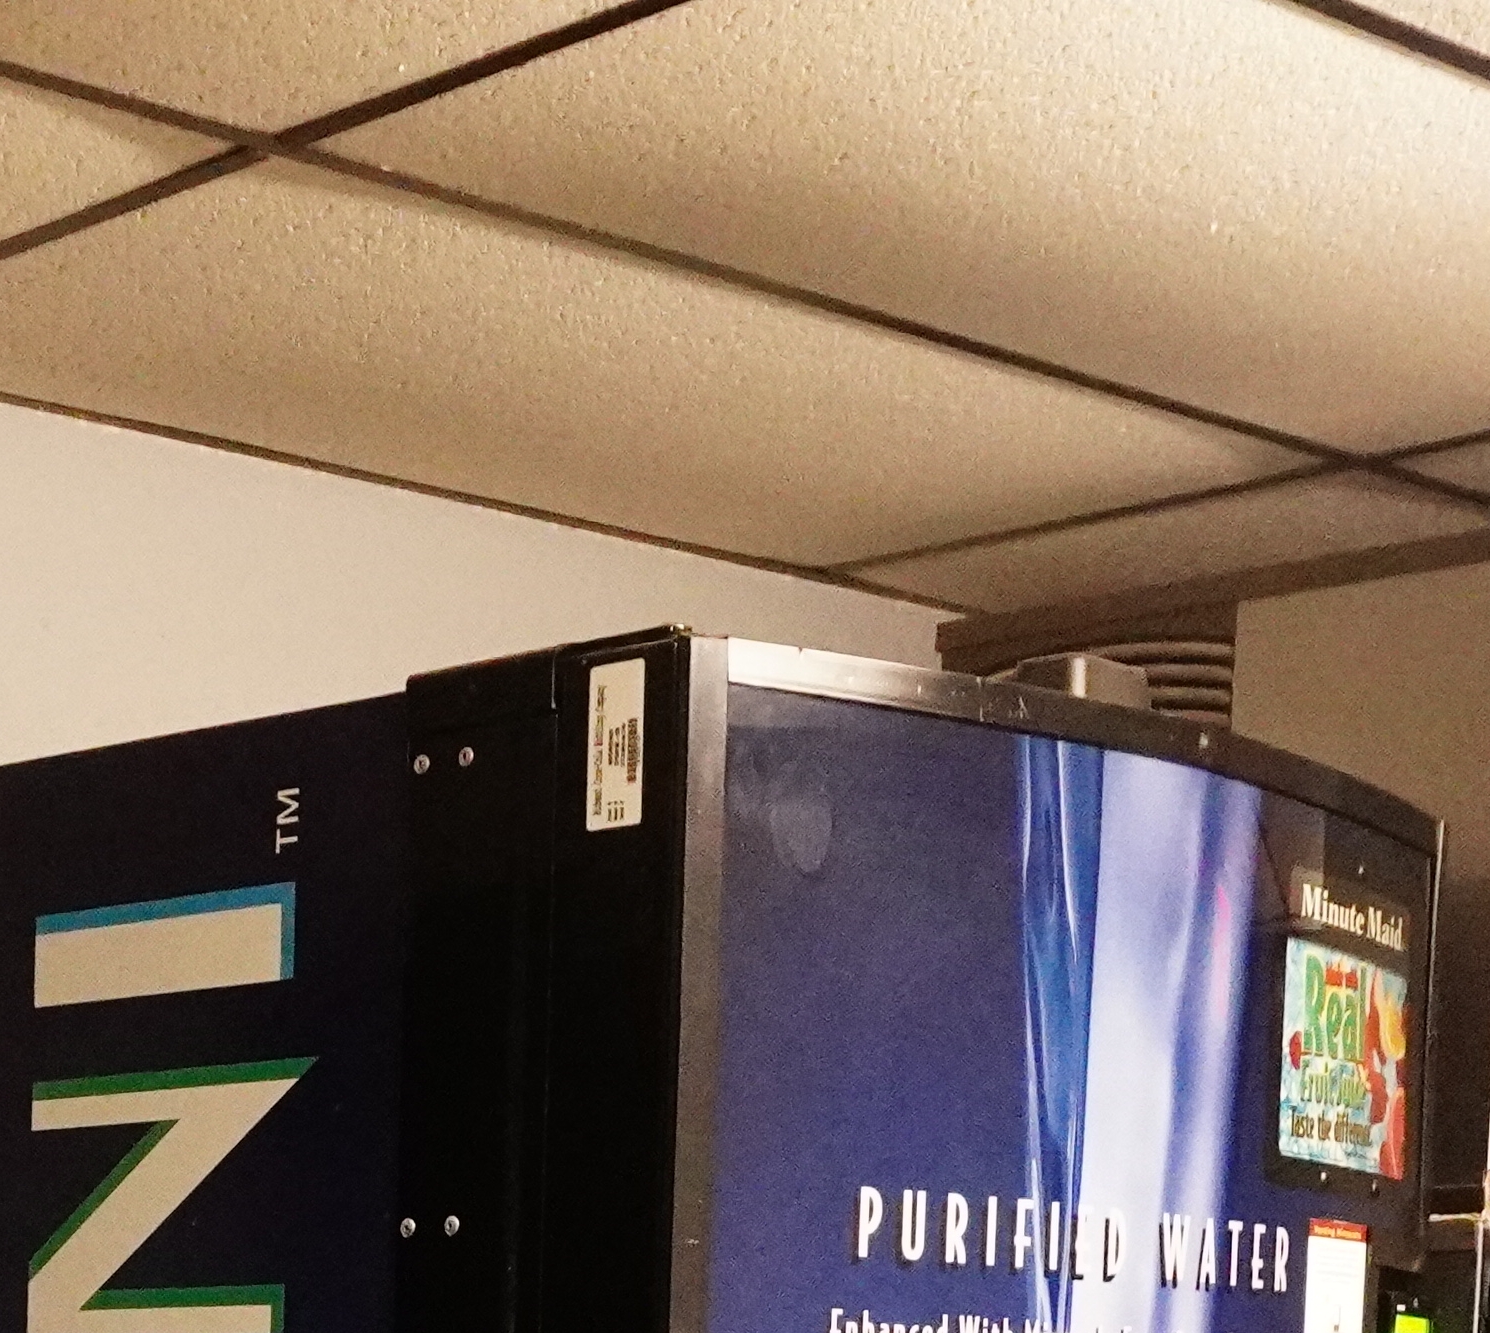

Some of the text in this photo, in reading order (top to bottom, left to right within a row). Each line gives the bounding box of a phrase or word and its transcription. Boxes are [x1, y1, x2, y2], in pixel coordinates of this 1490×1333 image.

[275, 786, 301, 854] TM
[1300, 882, 1405, 952] Minute Maid
[1290, 1105, 1316, 1139] Taste
[857, 1186, 1291, 1294] PURIFIED WATER
